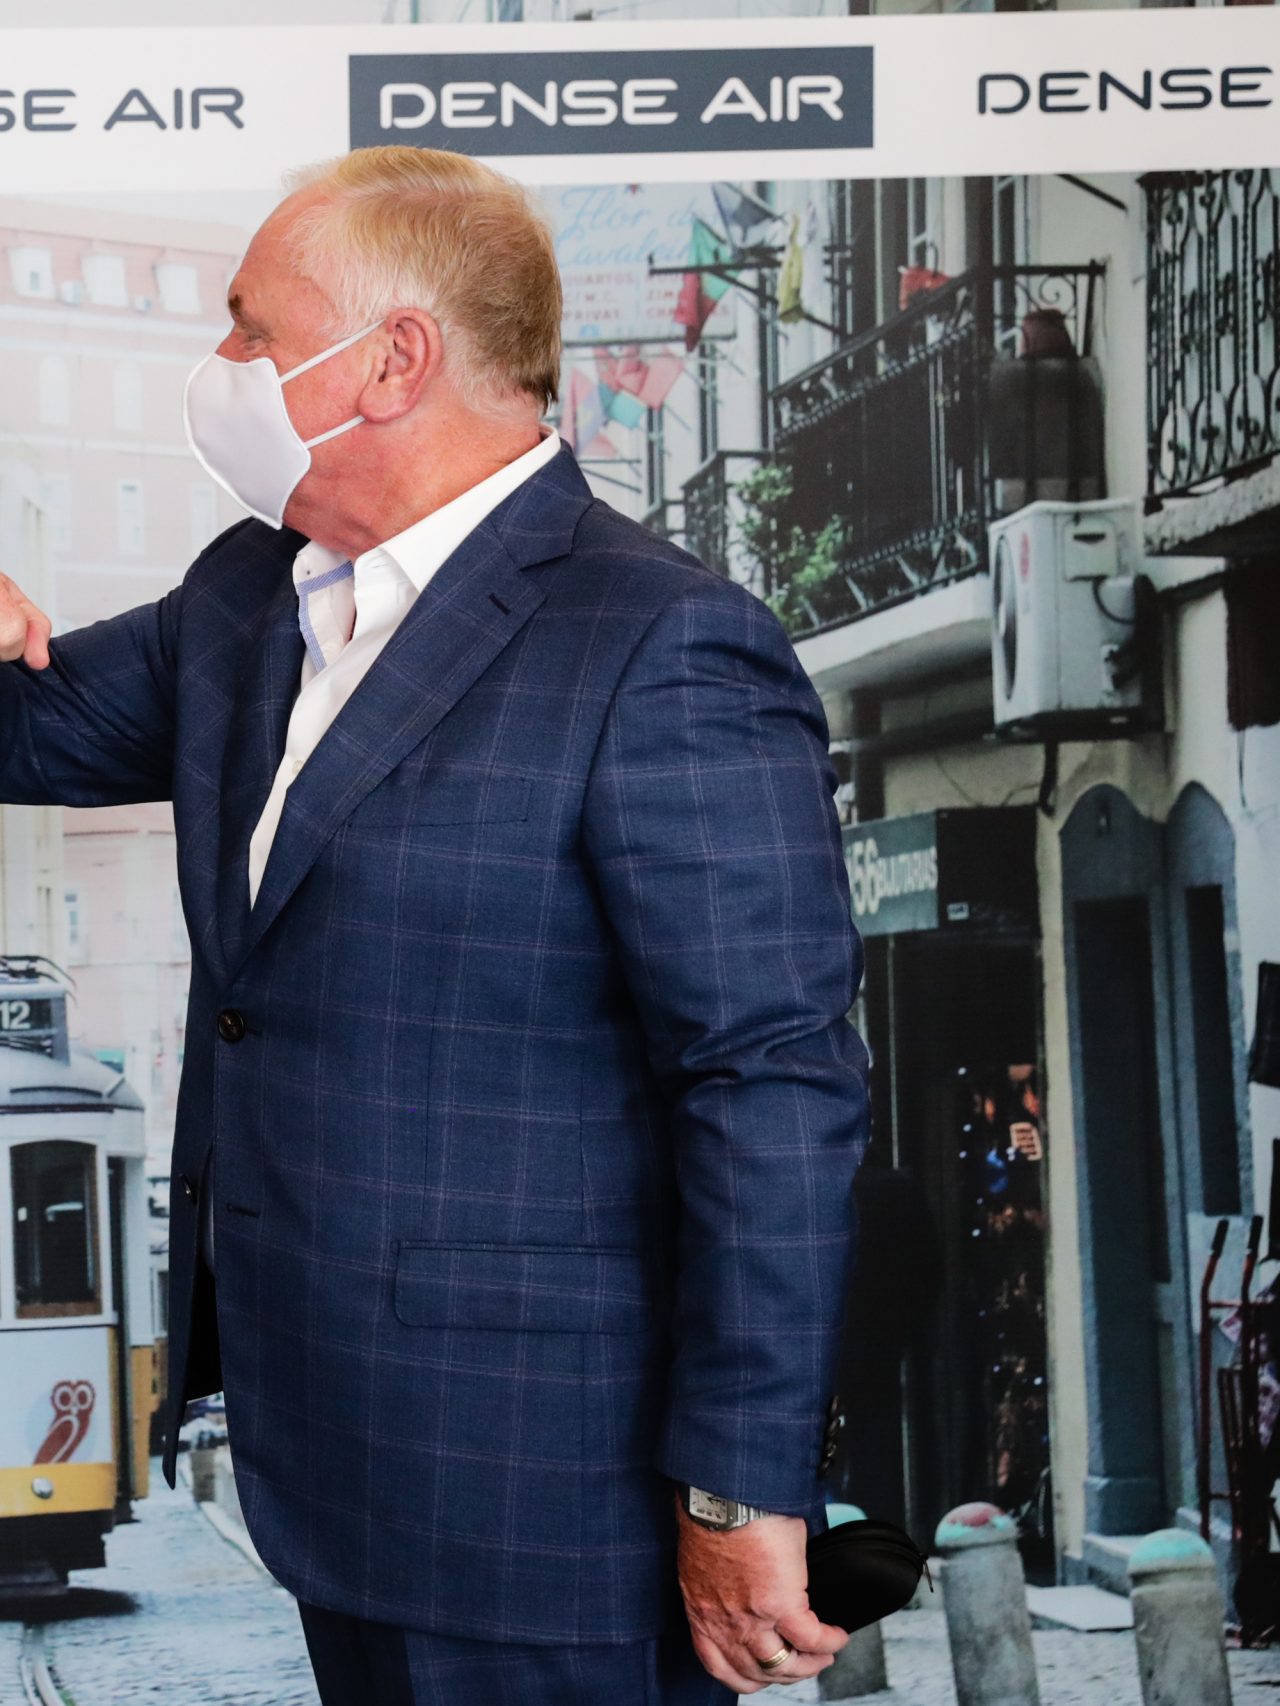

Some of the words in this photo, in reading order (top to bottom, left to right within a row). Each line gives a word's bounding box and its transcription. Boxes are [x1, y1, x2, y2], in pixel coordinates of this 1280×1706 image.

[103, 87, 244, 131] AIR
[379, 79, 678, 130] DENSE
[700, 76, 843, 123] AIR
[978, 66, 1273, 115] DENSE
